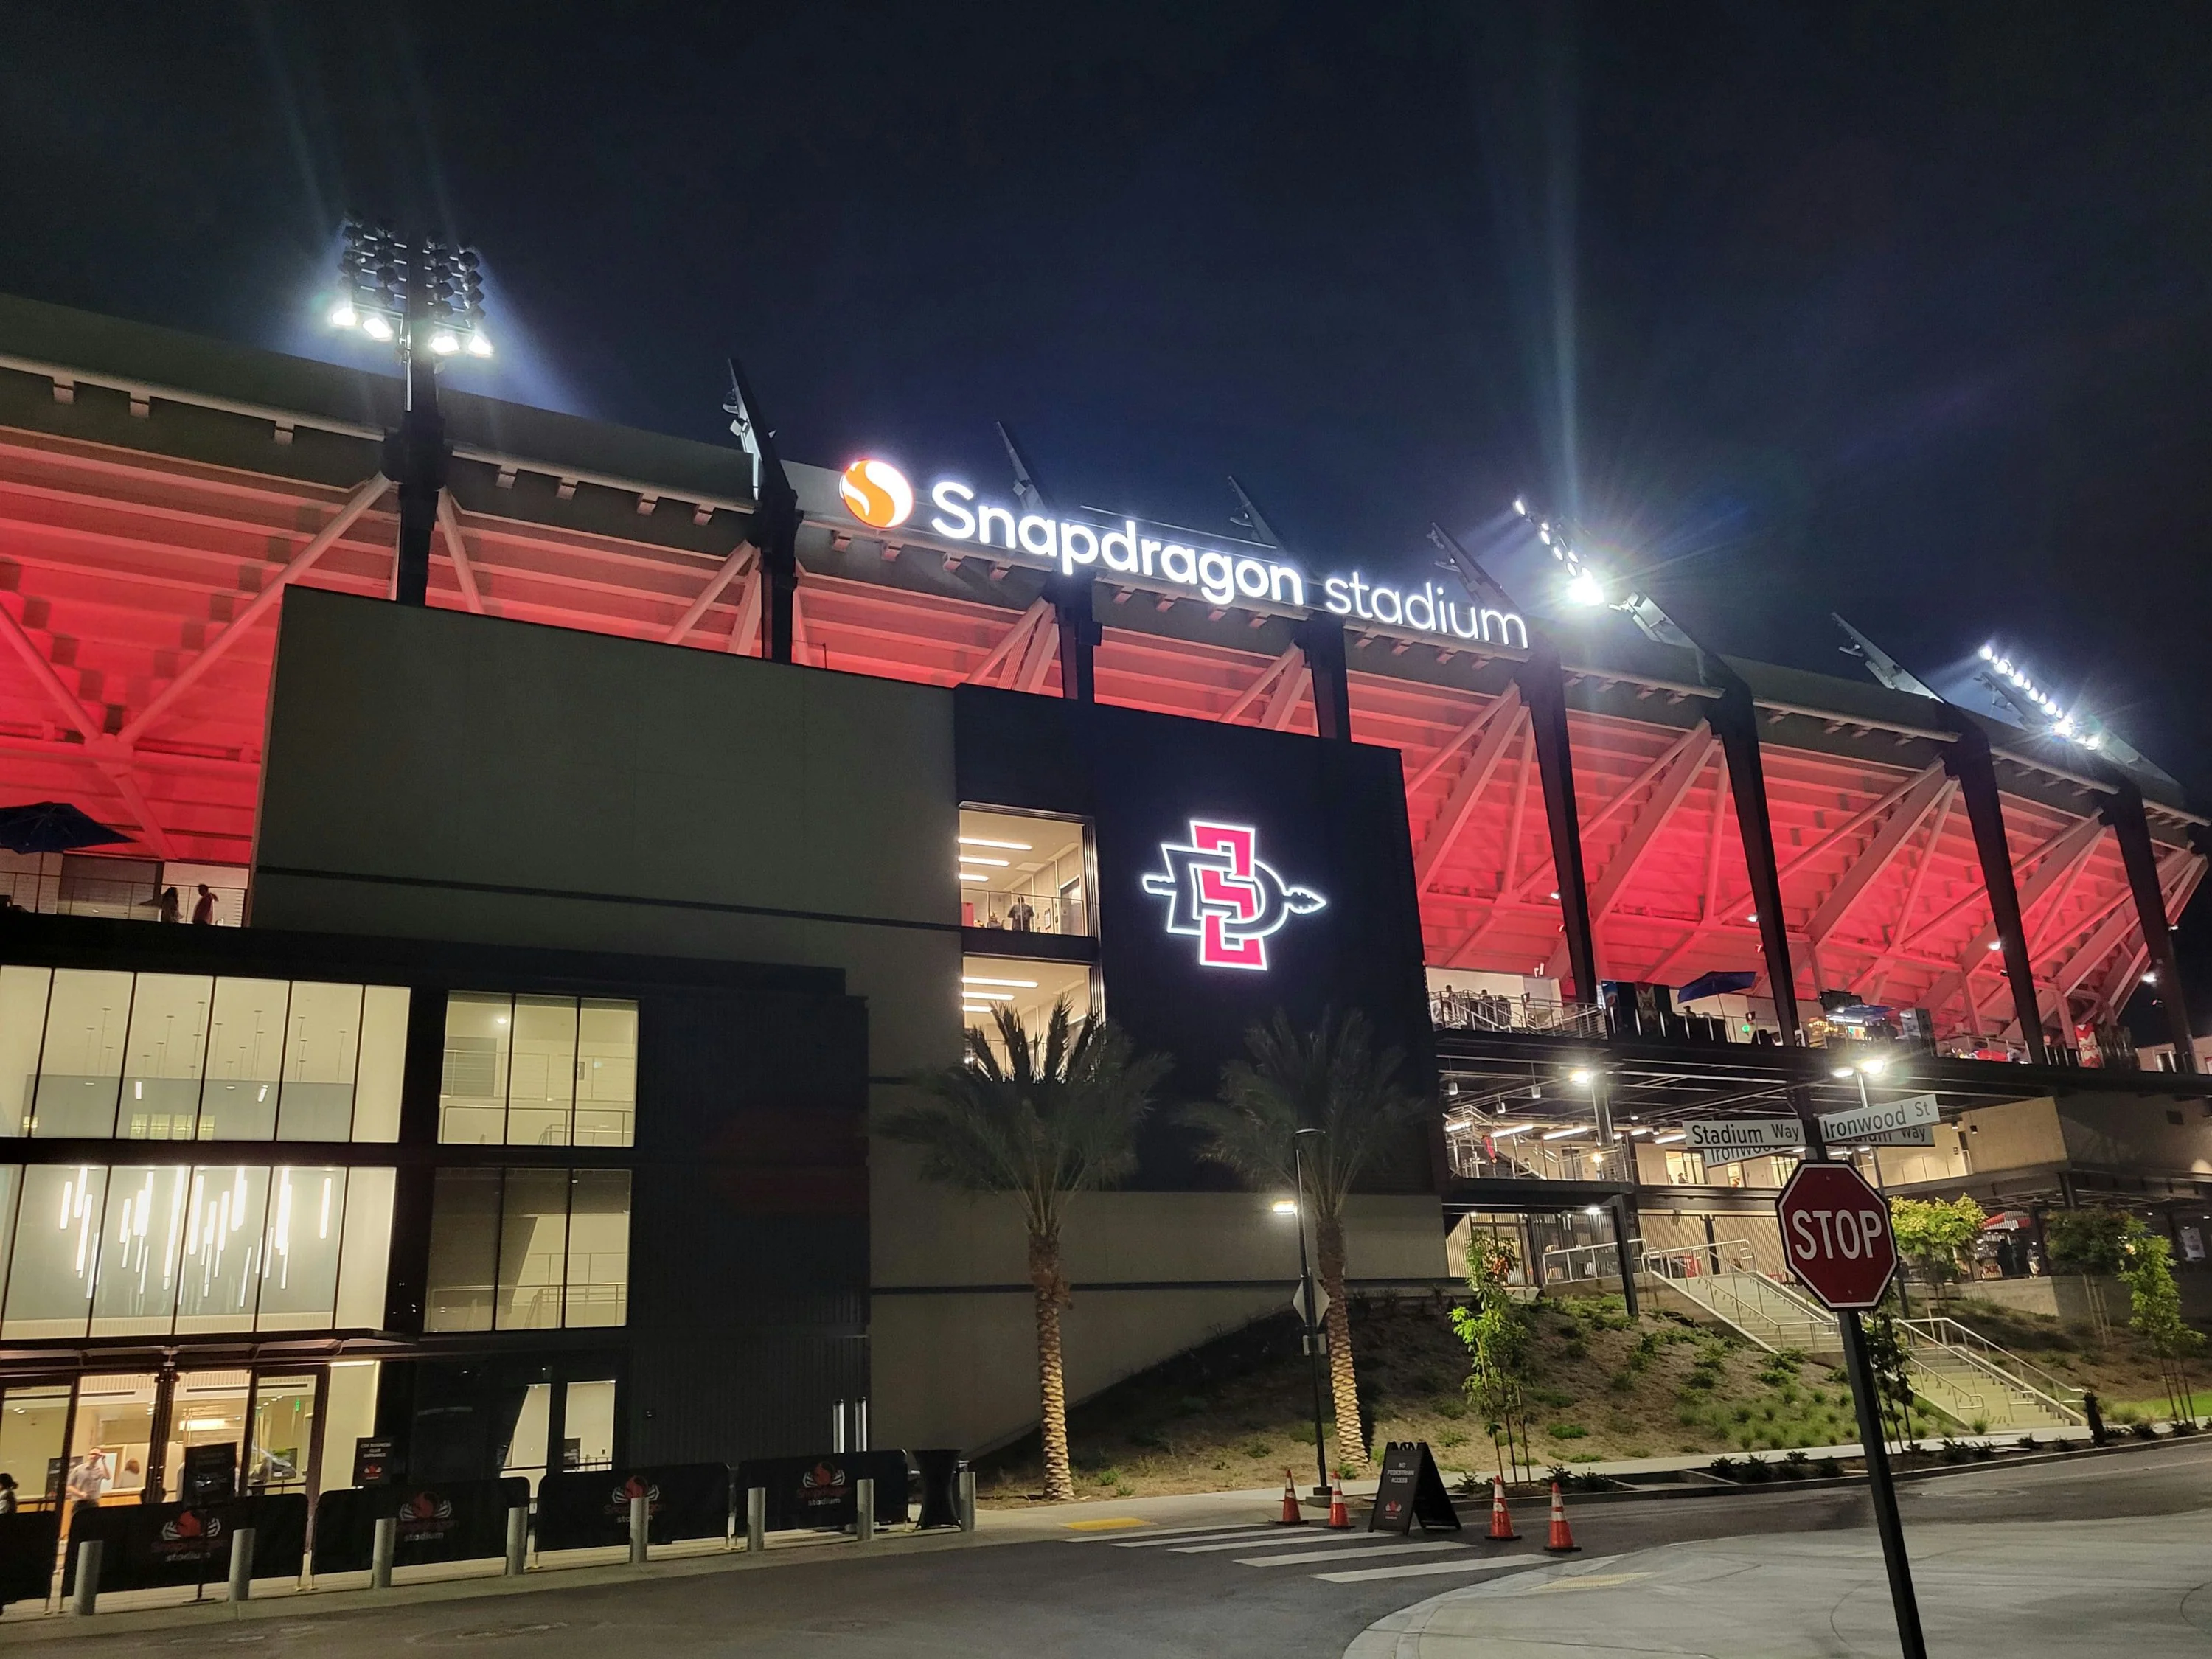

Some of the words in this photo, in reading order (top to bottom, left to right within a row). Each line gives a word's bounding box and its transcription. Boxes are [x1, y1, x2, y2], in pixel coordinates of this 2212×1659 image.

[931, 480, 1305, 605] Snapdragon
[1324, 571, 1529, 649] stadium
[1691, 1124, 1764, 1144] Stadium
[1770, 1123, 1800, 1142] Way
[1823, 1105, 1907, 1139] Ironwood
[1914, 1101, 1930, 1117] St
[1792, 1209, 1882, 1260] STOP
